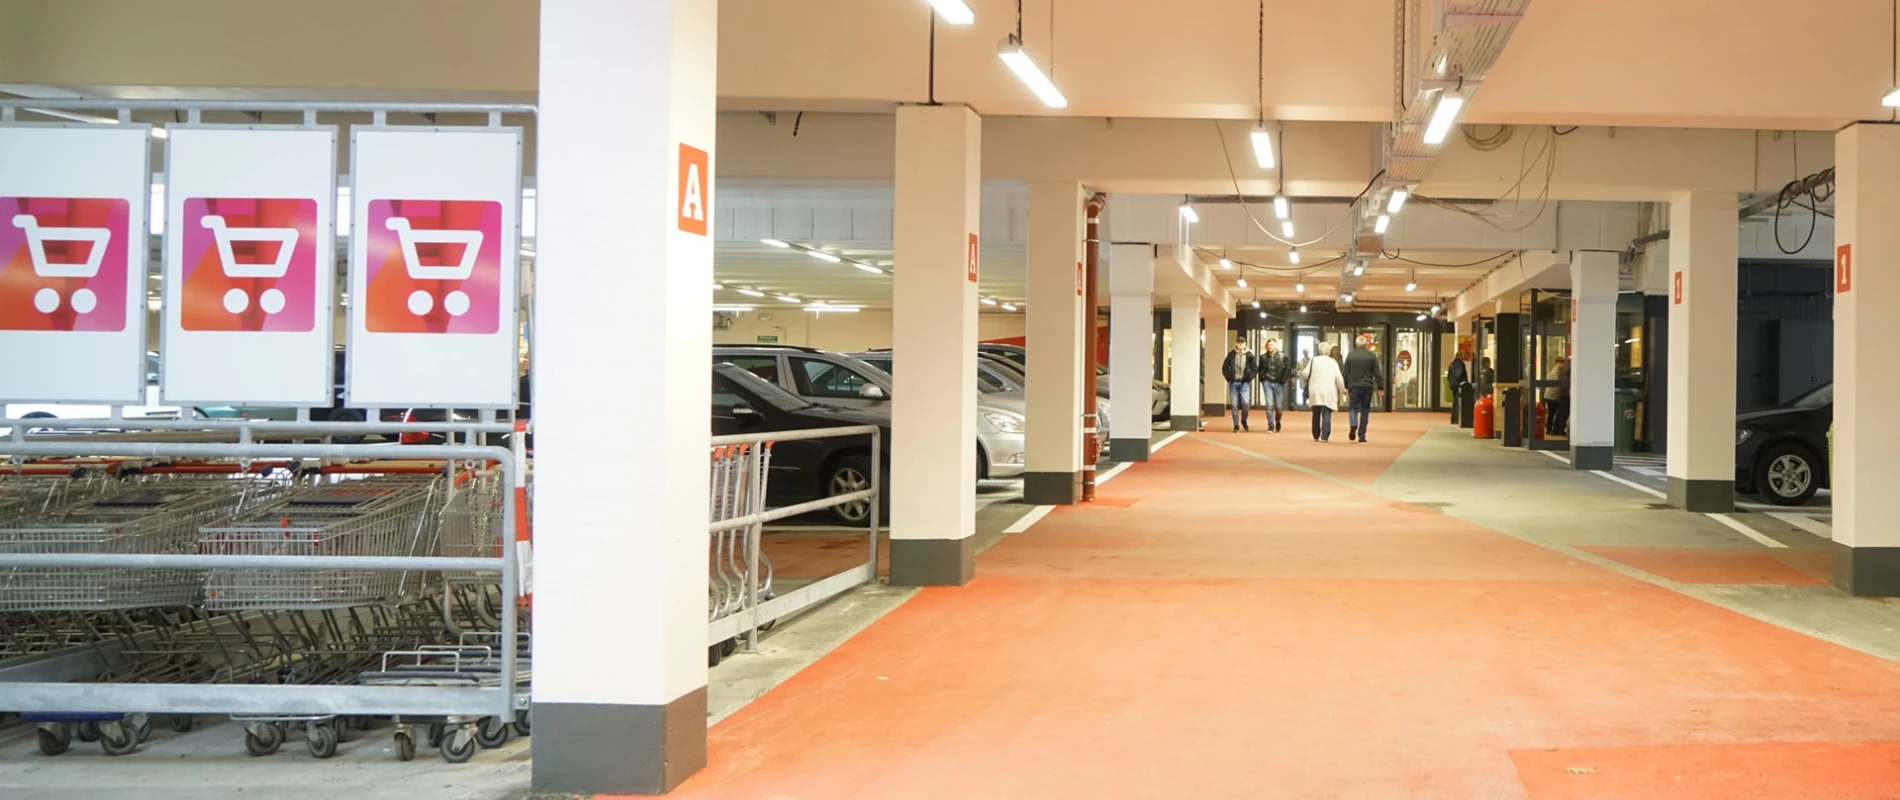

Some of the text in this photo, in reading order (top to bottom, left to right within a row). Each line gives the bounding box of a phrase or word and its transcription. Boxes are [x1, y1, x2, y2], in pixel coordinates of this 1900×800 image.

[682, 163, 704, 221] A
[969, 243, 976, 274] A
[1841, 253, 1847, 285] 1
